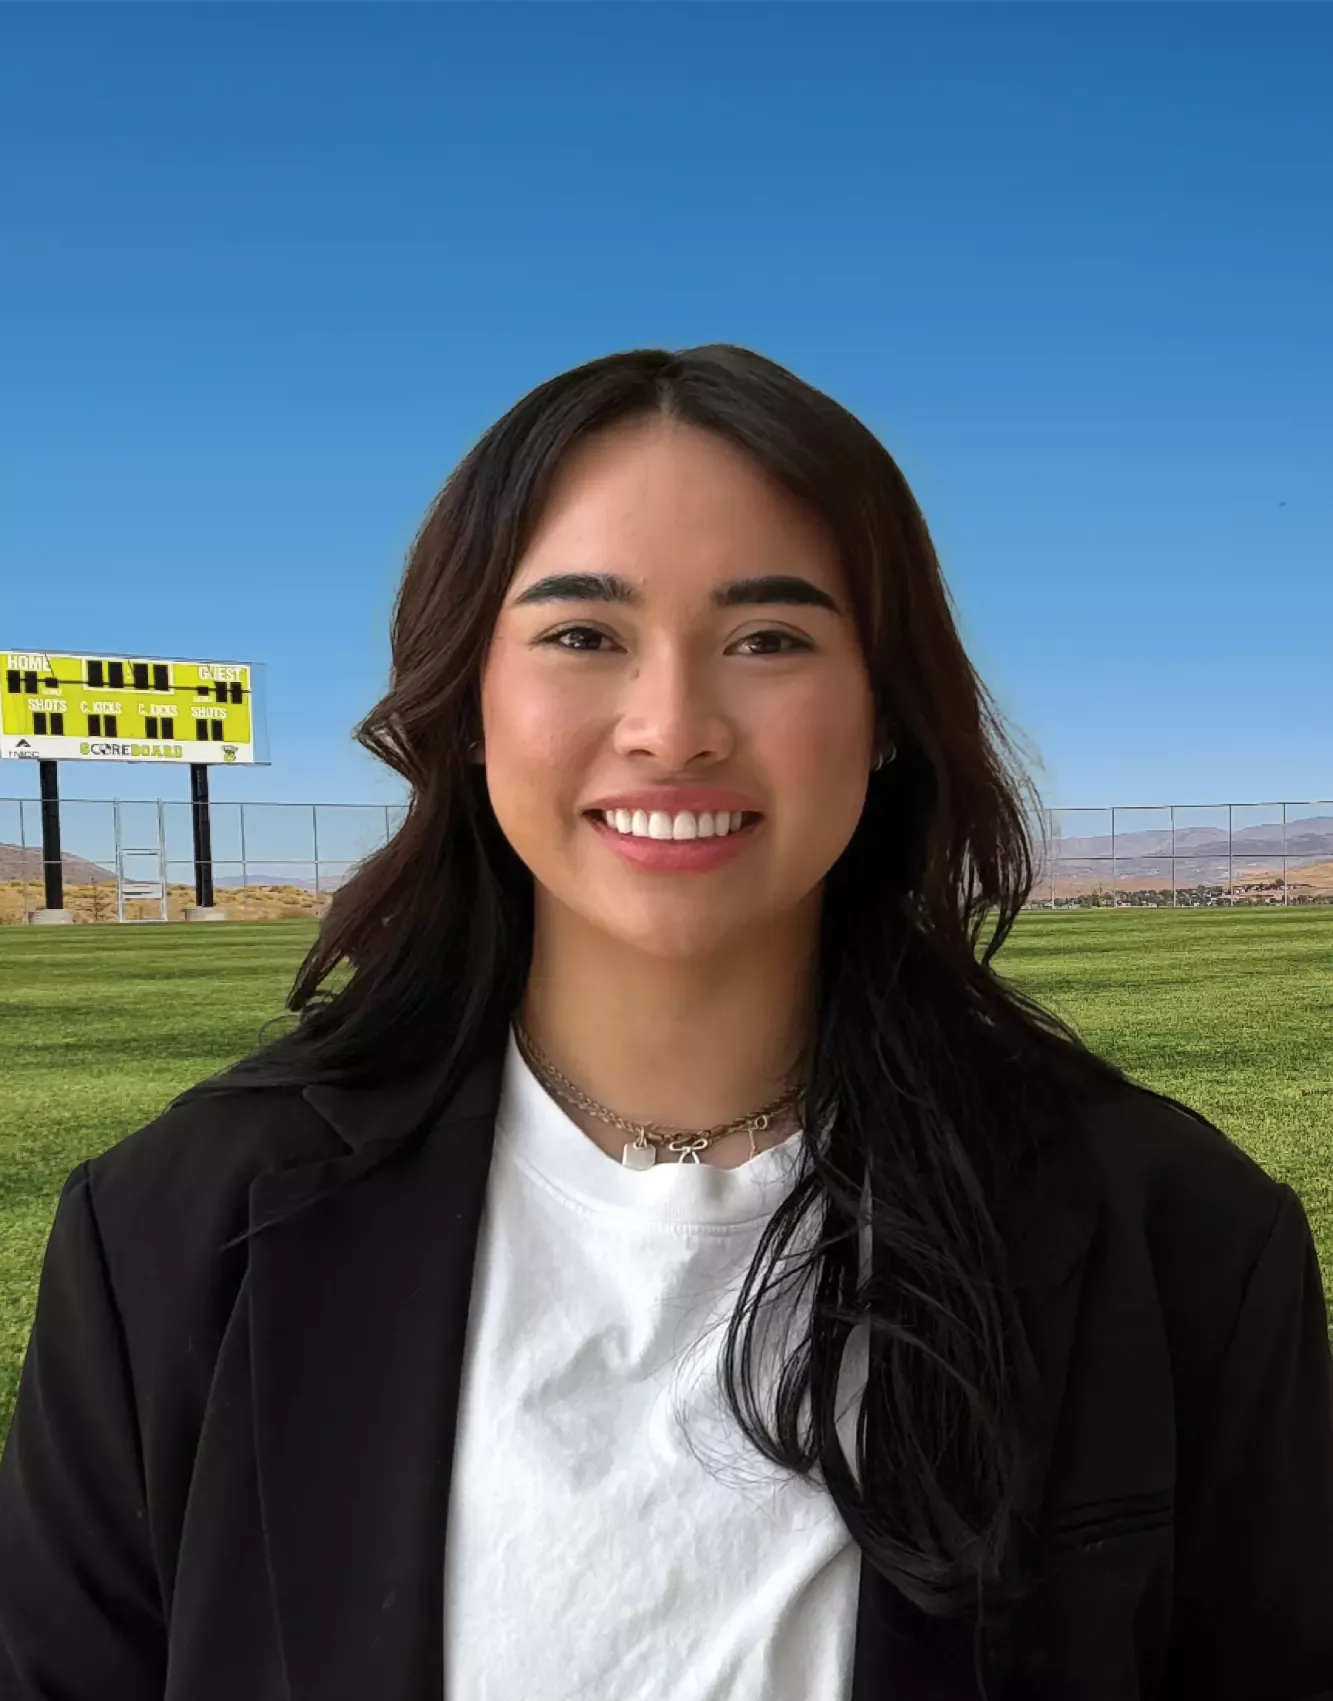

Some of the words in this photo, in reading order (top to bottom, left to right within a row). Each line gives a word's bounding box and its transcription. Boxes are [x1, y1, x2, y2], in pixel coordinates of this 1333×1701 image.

[8, 655, 51, 672] HOME
[198, 665, 241, 682] GUEST
[28, 699, 67, 712] SHOTS
[191, 706, 228, 719] SHOTS
[80, 742, 183, 758] SCOREBOARD
